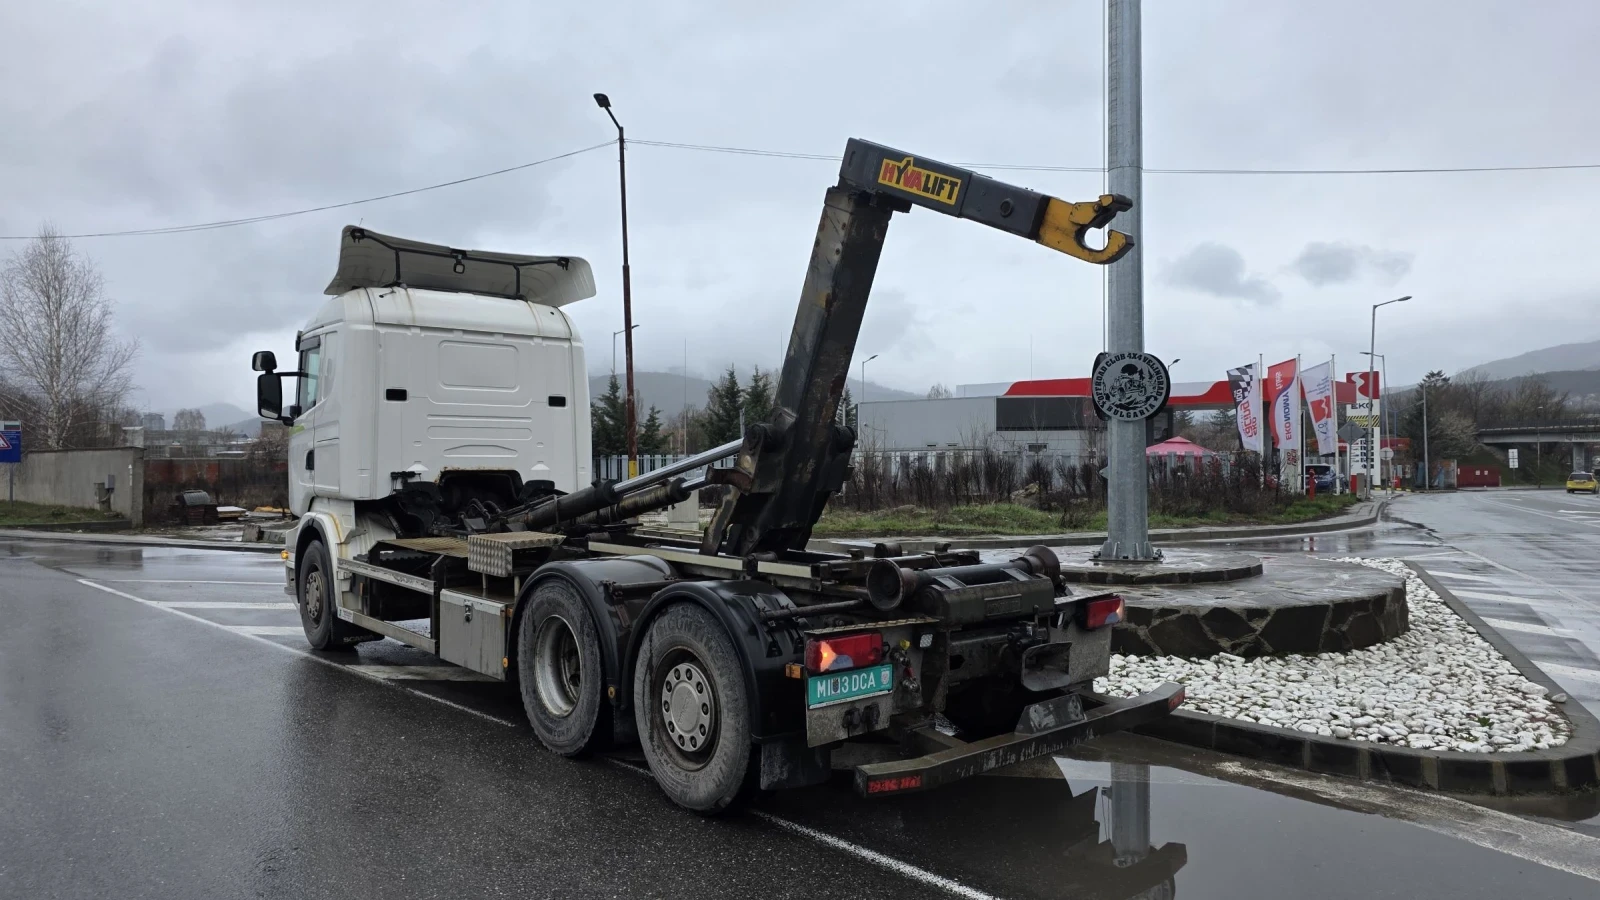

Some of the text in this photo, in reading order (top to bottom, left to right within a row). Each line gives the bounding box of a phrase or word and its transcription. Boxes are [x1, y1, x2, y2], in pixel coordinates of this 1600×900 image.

[881, 159, 958, 201] HYVALIFT
[1094, 366, 1108, 402] OFFROAD
[1105, 353, 1126, 368] CLUB
[1142, 356, 1164, 397] VELINGRAD
[1106, 404, 1156, 418] BULGARIA
